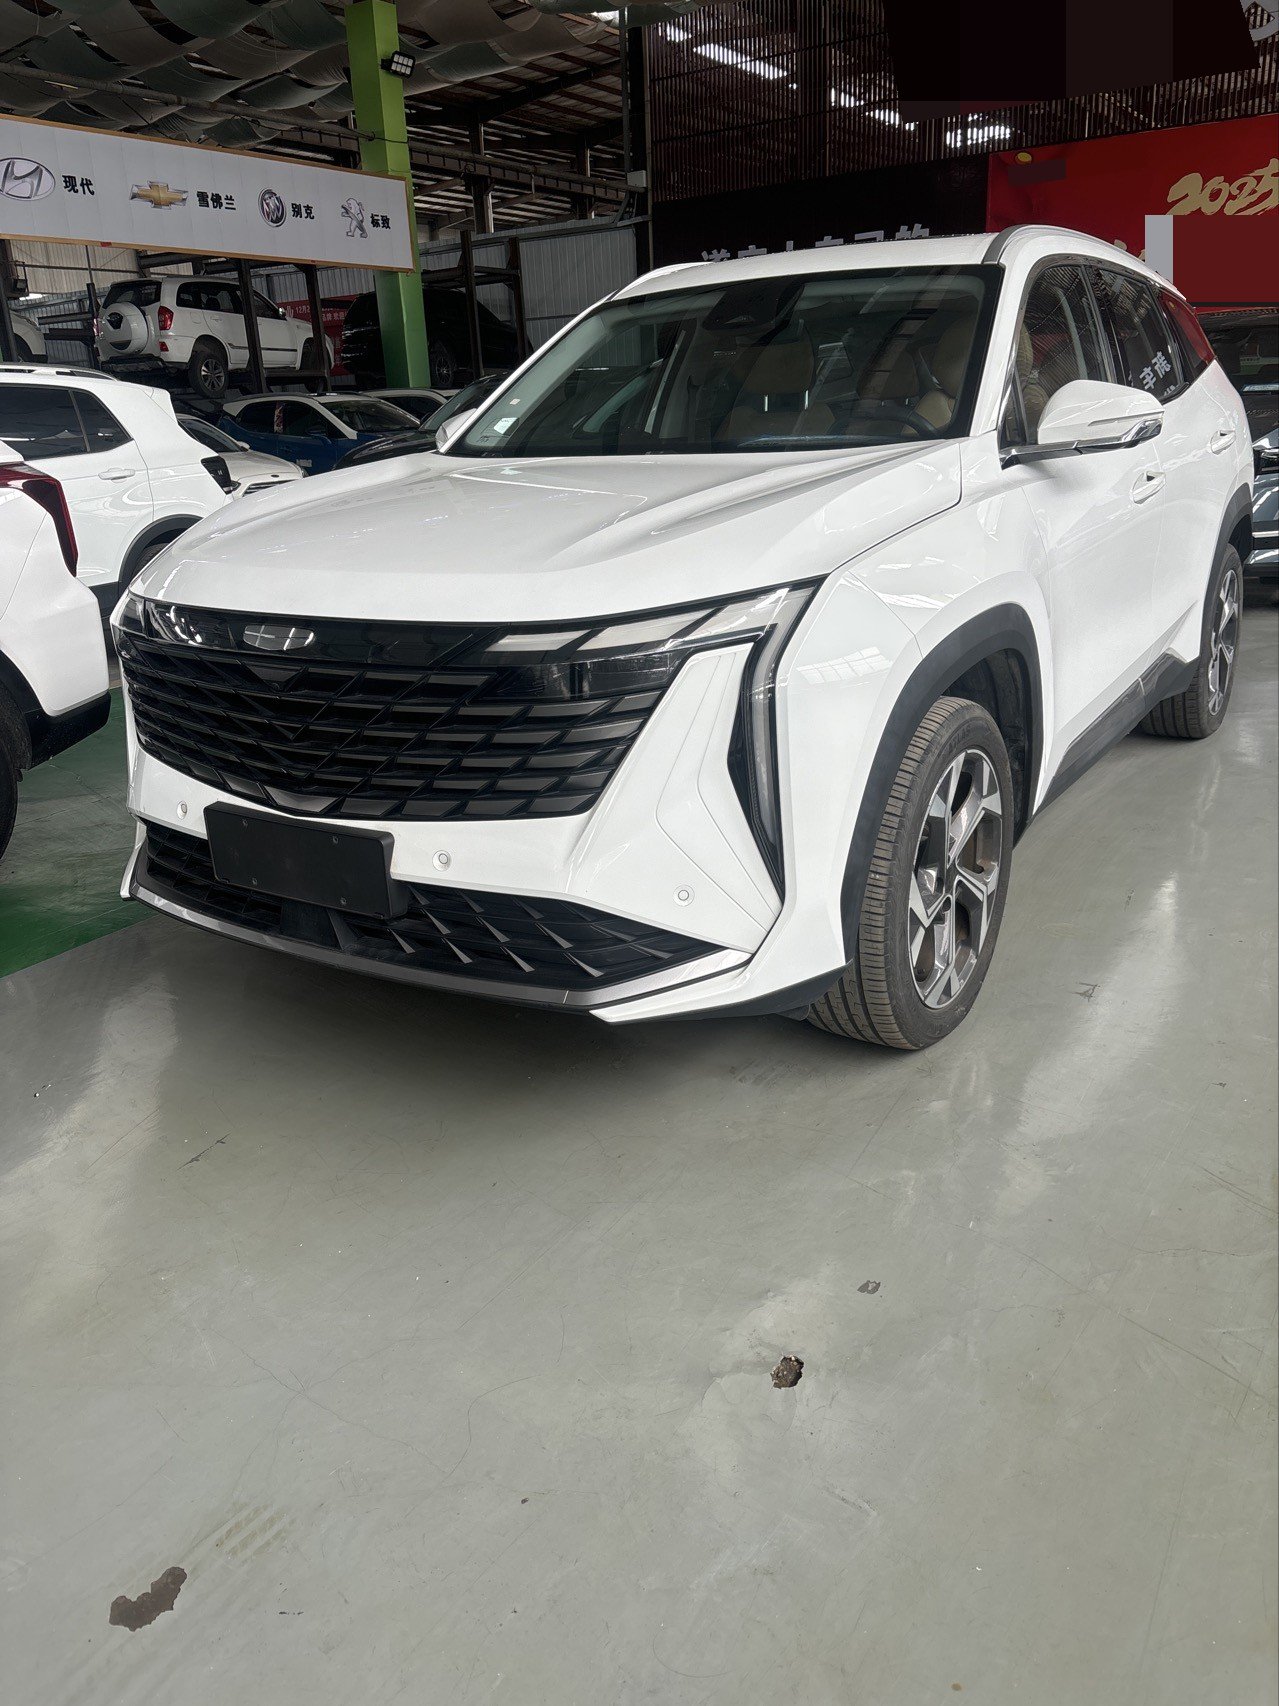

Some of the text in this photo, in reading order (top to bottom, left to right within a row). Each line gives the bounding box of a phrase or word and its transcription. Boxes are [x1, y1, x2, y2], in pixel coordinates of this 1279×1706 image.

[61, 174, 391, 229] 现代 雪佛兰 别克 标致
